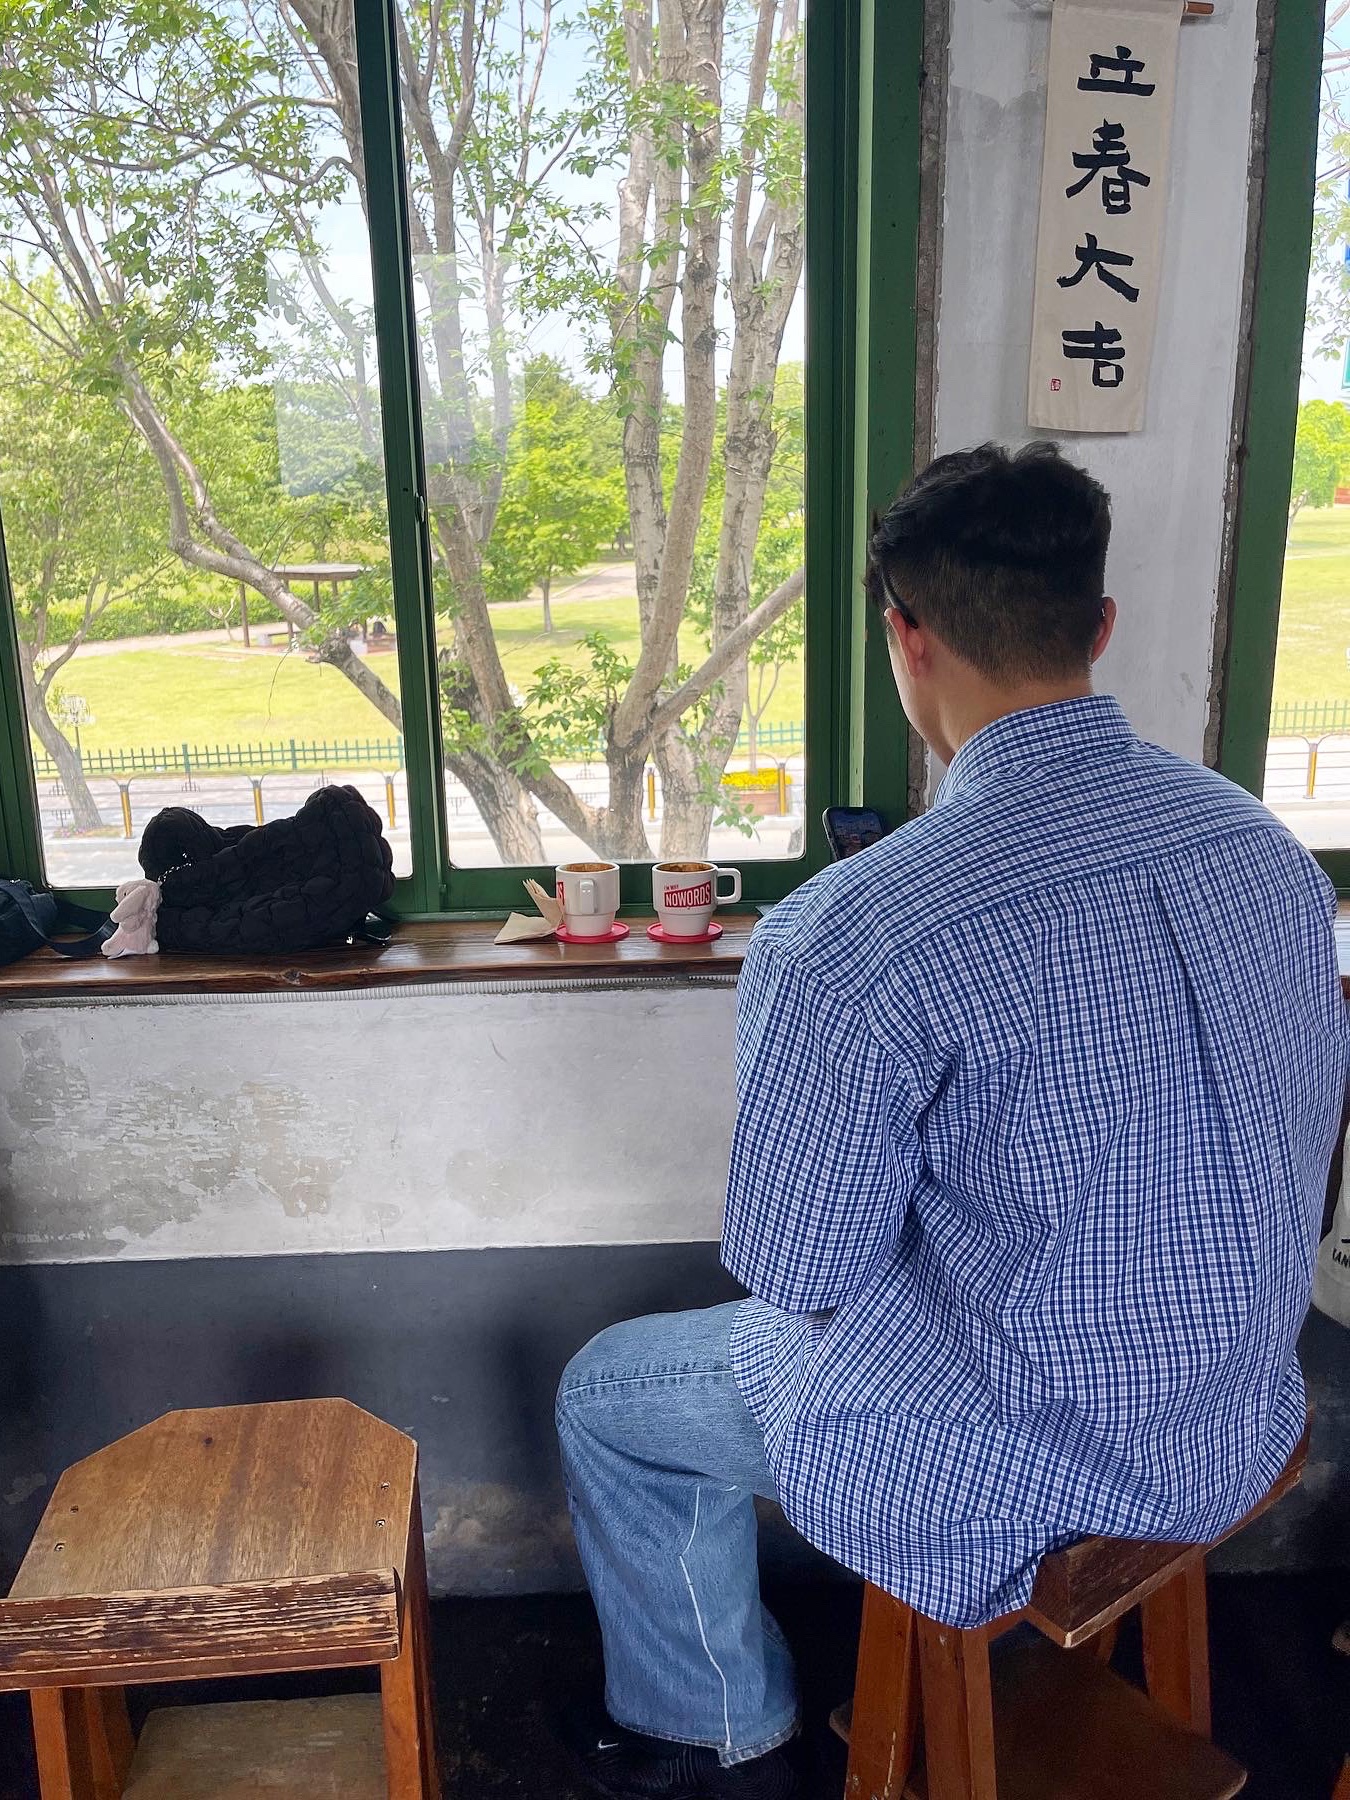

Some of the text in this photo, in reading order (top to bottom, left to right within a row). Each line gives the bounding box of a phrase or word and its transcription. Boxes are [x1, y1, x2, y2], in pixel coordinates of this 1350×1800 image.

[1057, 46, 1155, 387] 立春大吉
[665, 884, 711, 907] NOWORDS
